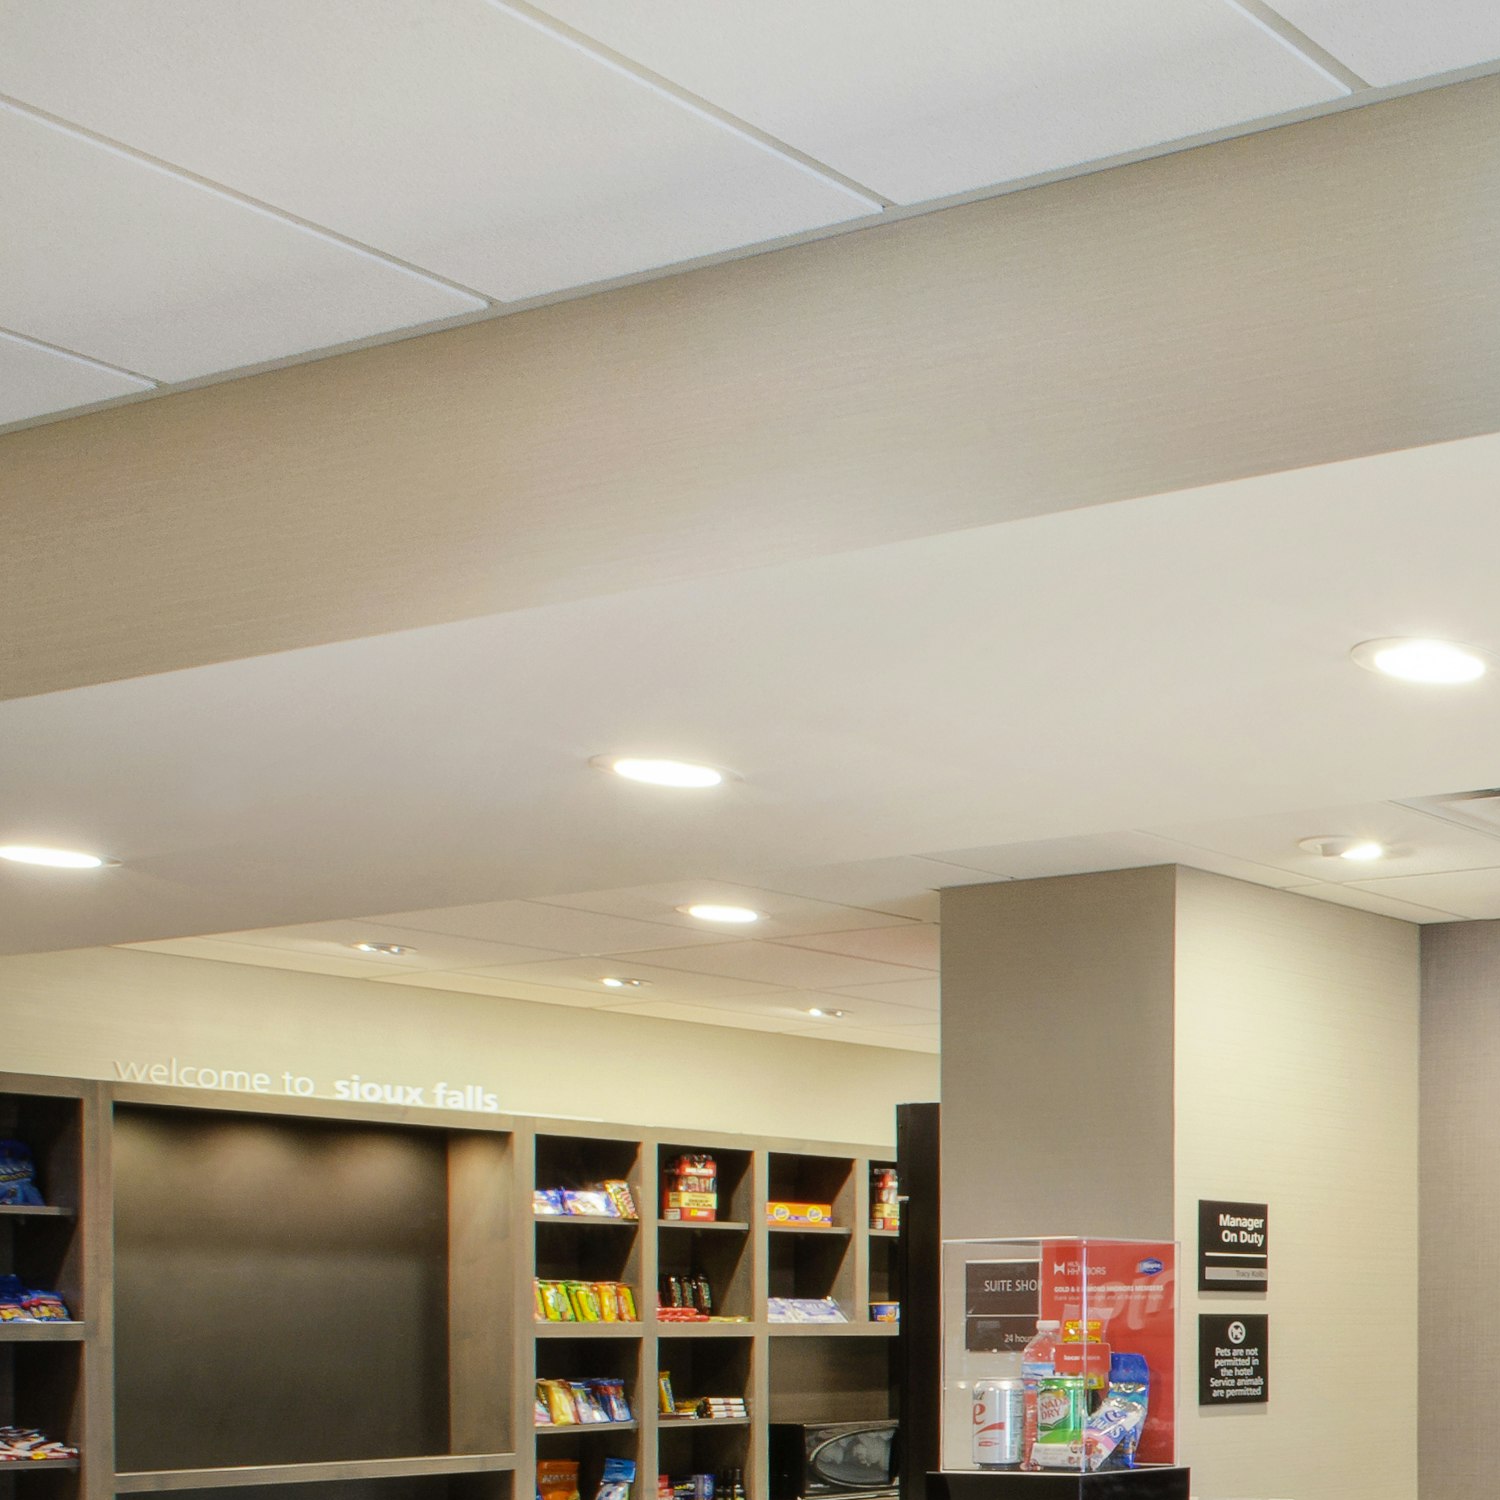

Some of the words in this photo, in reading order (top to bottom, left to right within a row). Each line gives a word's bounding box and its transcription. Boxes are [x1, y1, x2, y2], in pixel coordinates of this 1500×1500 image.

[113, 1057, 271, 1093] welcome
[282, 1071, 315, 1097] to
[334, 1074, 425, 1106] sioux
[433, 1081, 499, 1112] falls
[1219, 1213, 1264, 1231] Manager
[1221, 1230, 1238, 1243] On
[1239, 1231, 1265, 1247] Duty
[984, 1280, 1012, 1292] SUITE
[1215, 1347, 1231, 1357] Pets
[1232, 1348, 1244, 1356] are
[1245, 1347, 1259, 1356] not
[1214, 1356, 1251, 1369] permitted
[1252, 1357, 1260, 1366] in
[1221, 1368, 1233, 1377] the
[1234, 1366, 1254, 1376] hotel
[1210, 1377, 1236, 1387] Service
[1236, 1376, 1264, 1386] animals
[1212, 1389, 1225, 1398] are
[1225, 1386, 1262, 1399] permitted
